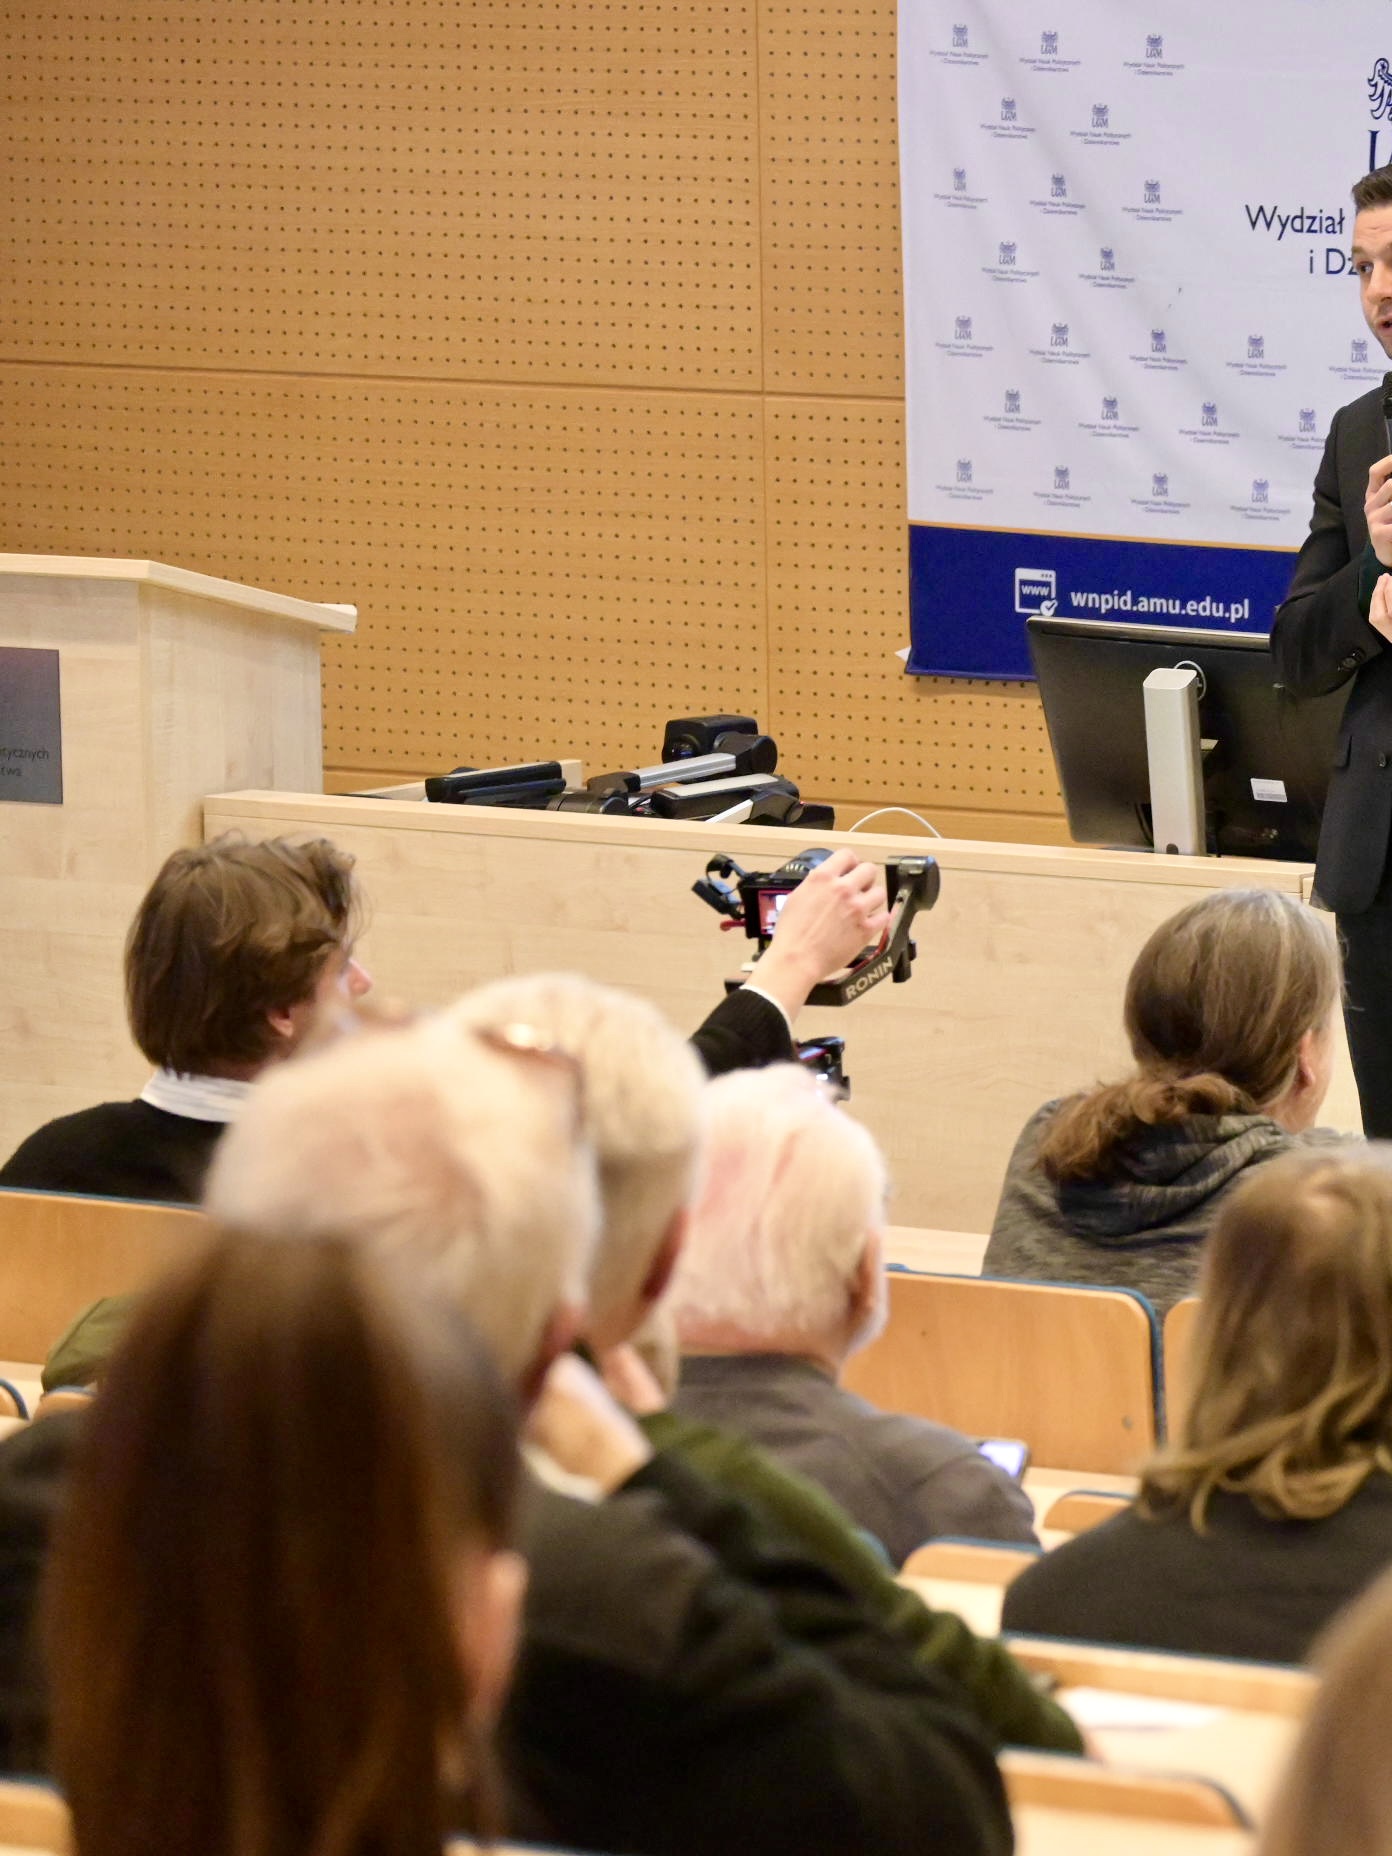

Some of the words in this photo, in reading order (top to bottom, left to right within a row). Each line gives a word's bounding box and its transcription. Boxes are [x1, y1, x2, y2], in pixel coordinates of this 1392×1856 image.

[1245, 204, 1346, 241] Wydział
[1070, 589, 1250, 623] wnpid.amu.edu.pl
[845, 955, 894, 1000] RONIN
